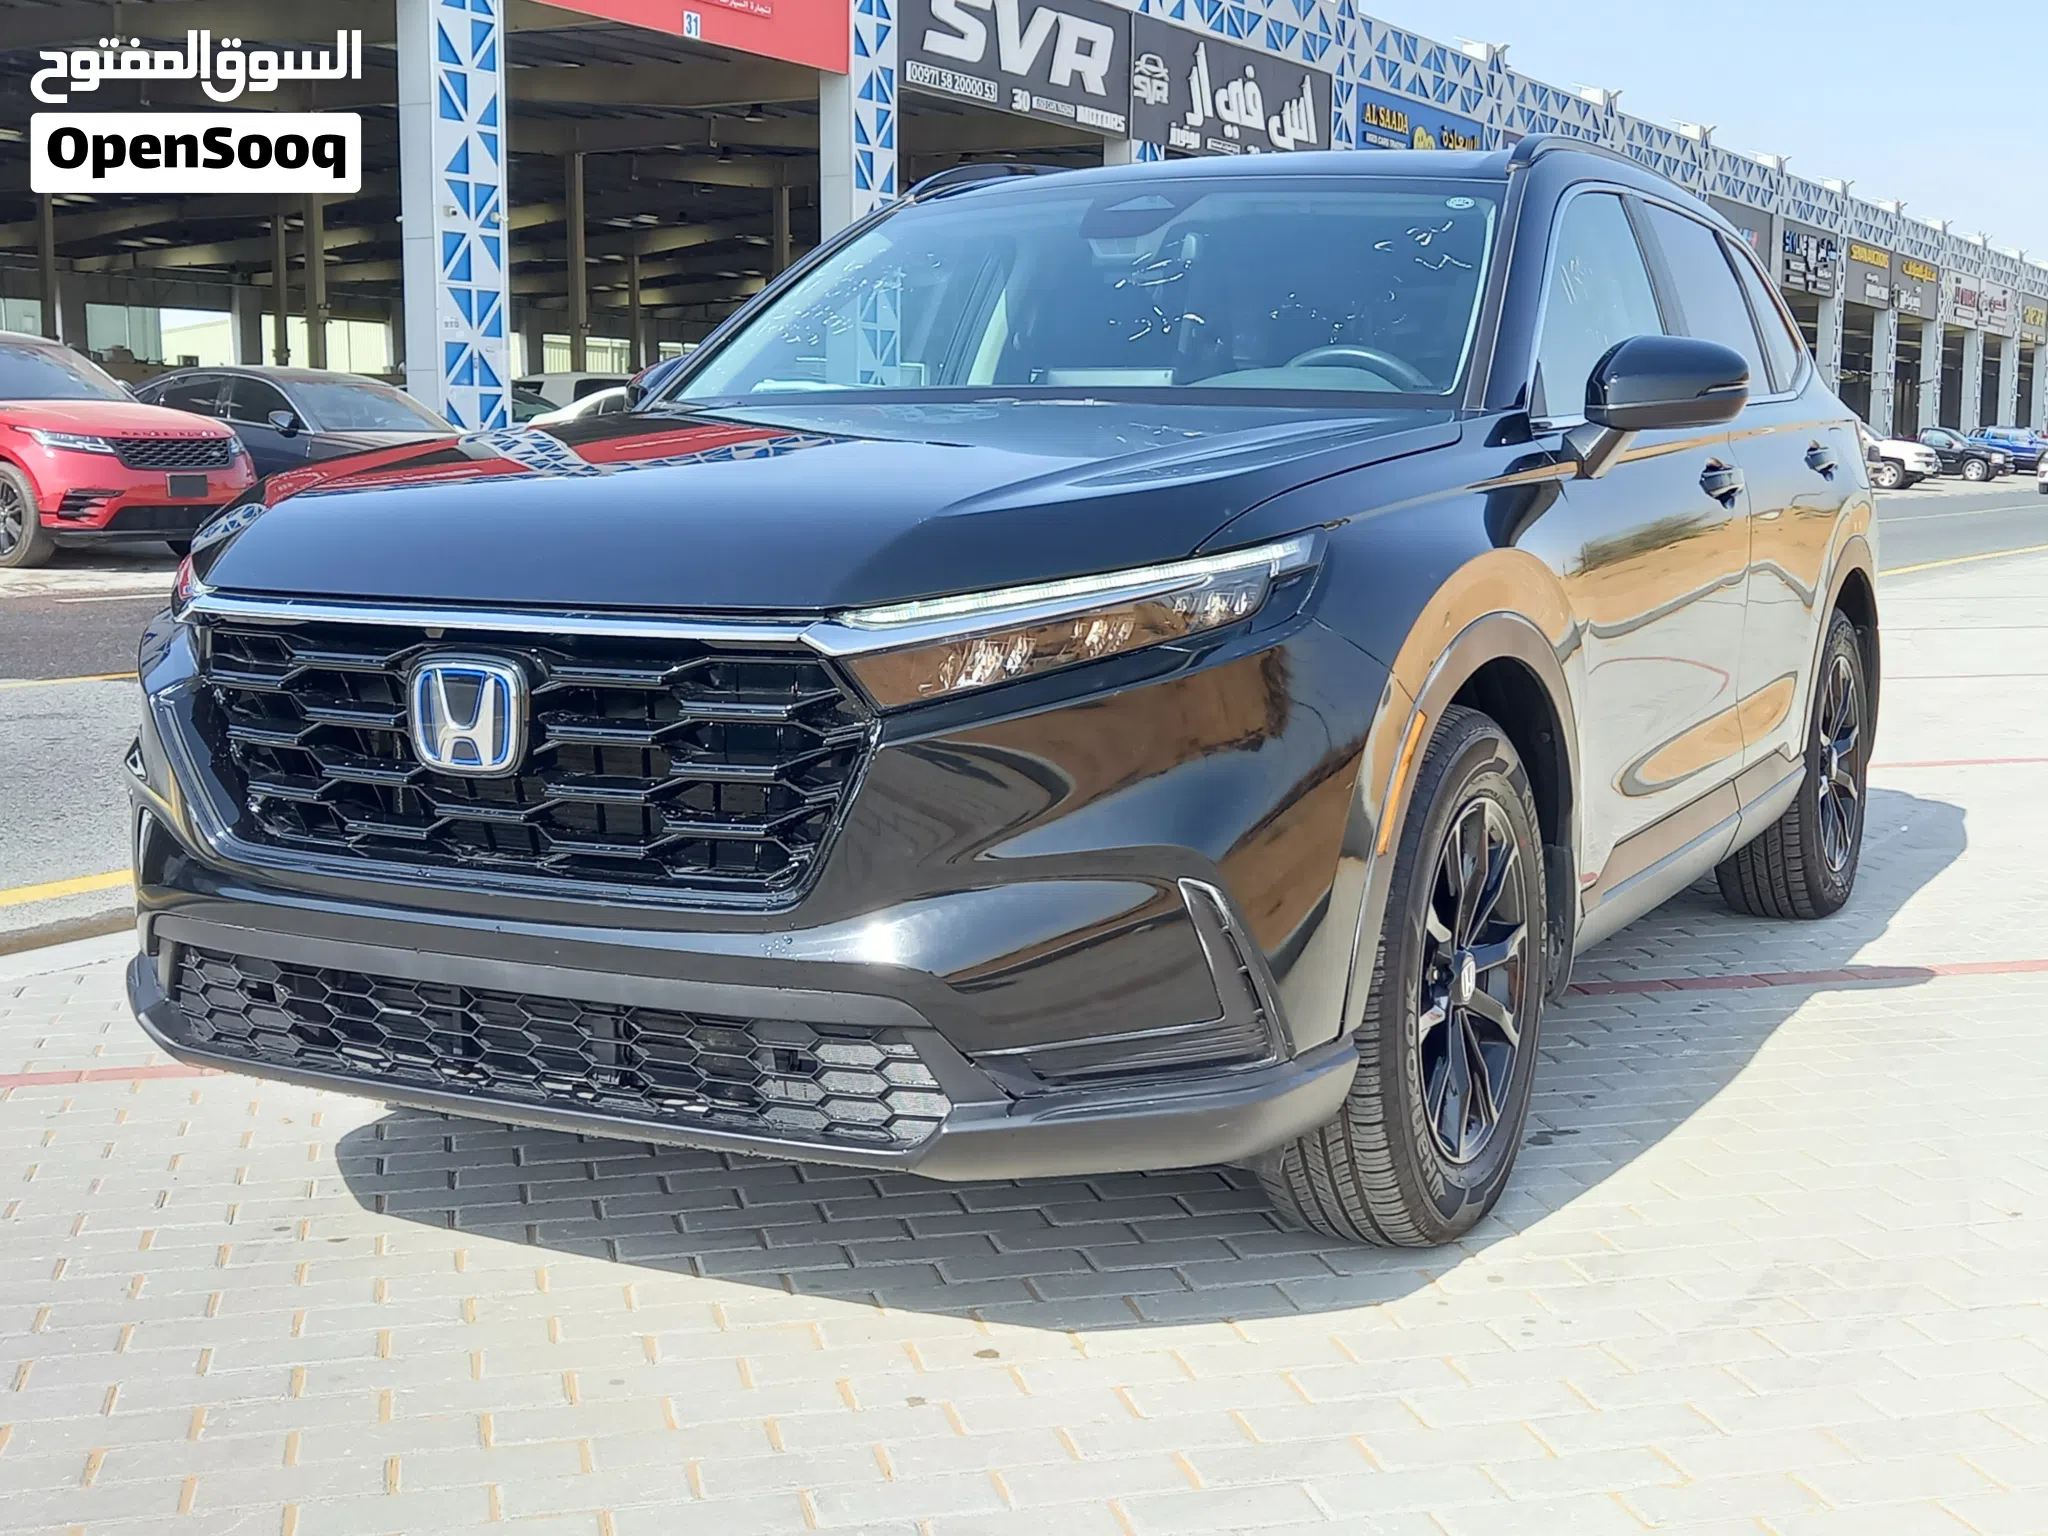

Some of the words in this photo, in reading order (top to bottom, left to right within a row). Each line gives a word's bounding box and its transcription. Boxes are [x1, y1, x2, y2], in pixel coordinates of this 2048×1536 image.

[685, 13, 699, 37] 31
[922, 0, 1114, 97] SVR
[911, 63, 940, 87] 00971
[941, 72, 953, 89] 58
[954, 76, 983, 96] 20000
[984, 82, 996, 99] 53
[1133, 74, 1170, 105] SVR
[1011, 88, 1031, 112] 30
[1076, 104, 1126, 132] MOTORS
[1364, 103, 1378, 125] AL
[1378, 106, 1409, 135] SAADA
